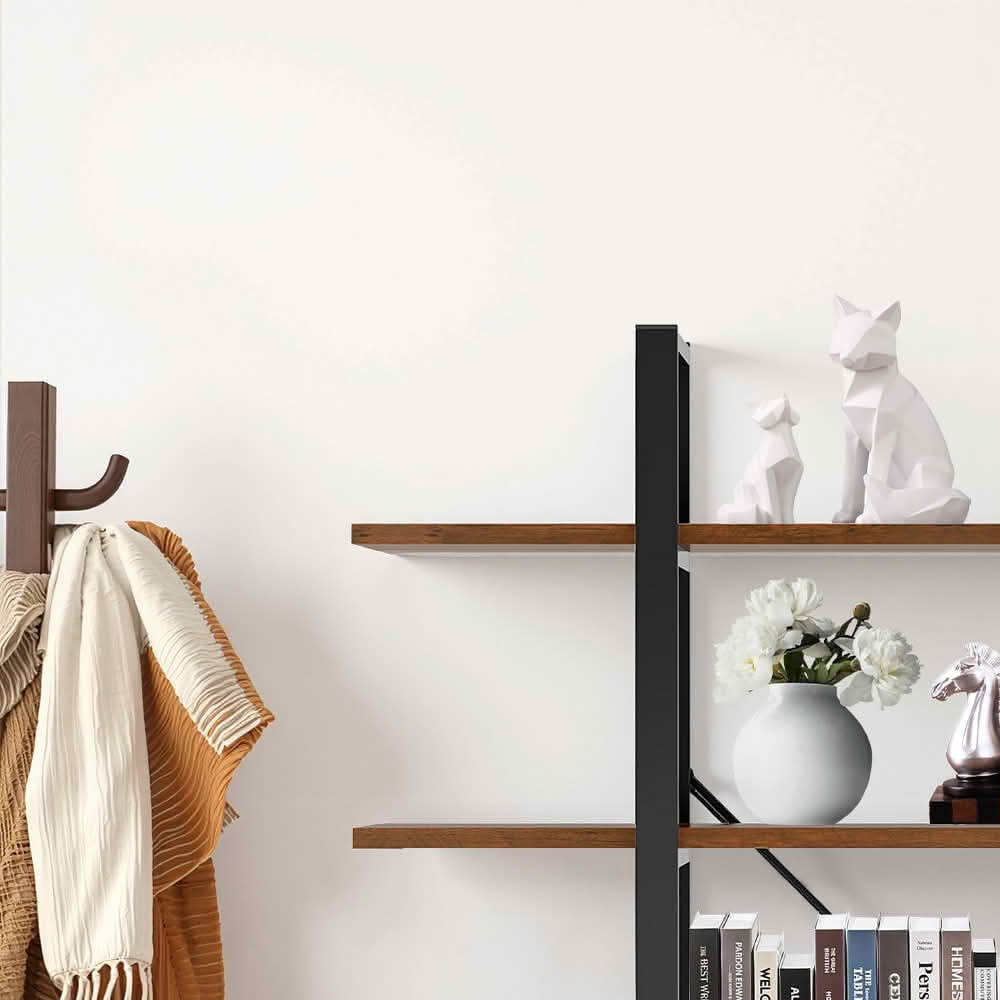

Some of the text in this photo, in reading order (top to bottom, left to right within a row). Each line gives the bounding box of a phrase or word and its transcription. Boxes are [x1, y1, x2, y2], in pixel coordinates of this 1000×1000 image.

[700, 958, 709, 983] BEST
[734, 942, 743, 976] PARDON
[951, 946, 963, 1000] HOMES
[864, 969, 872, 986] THE
